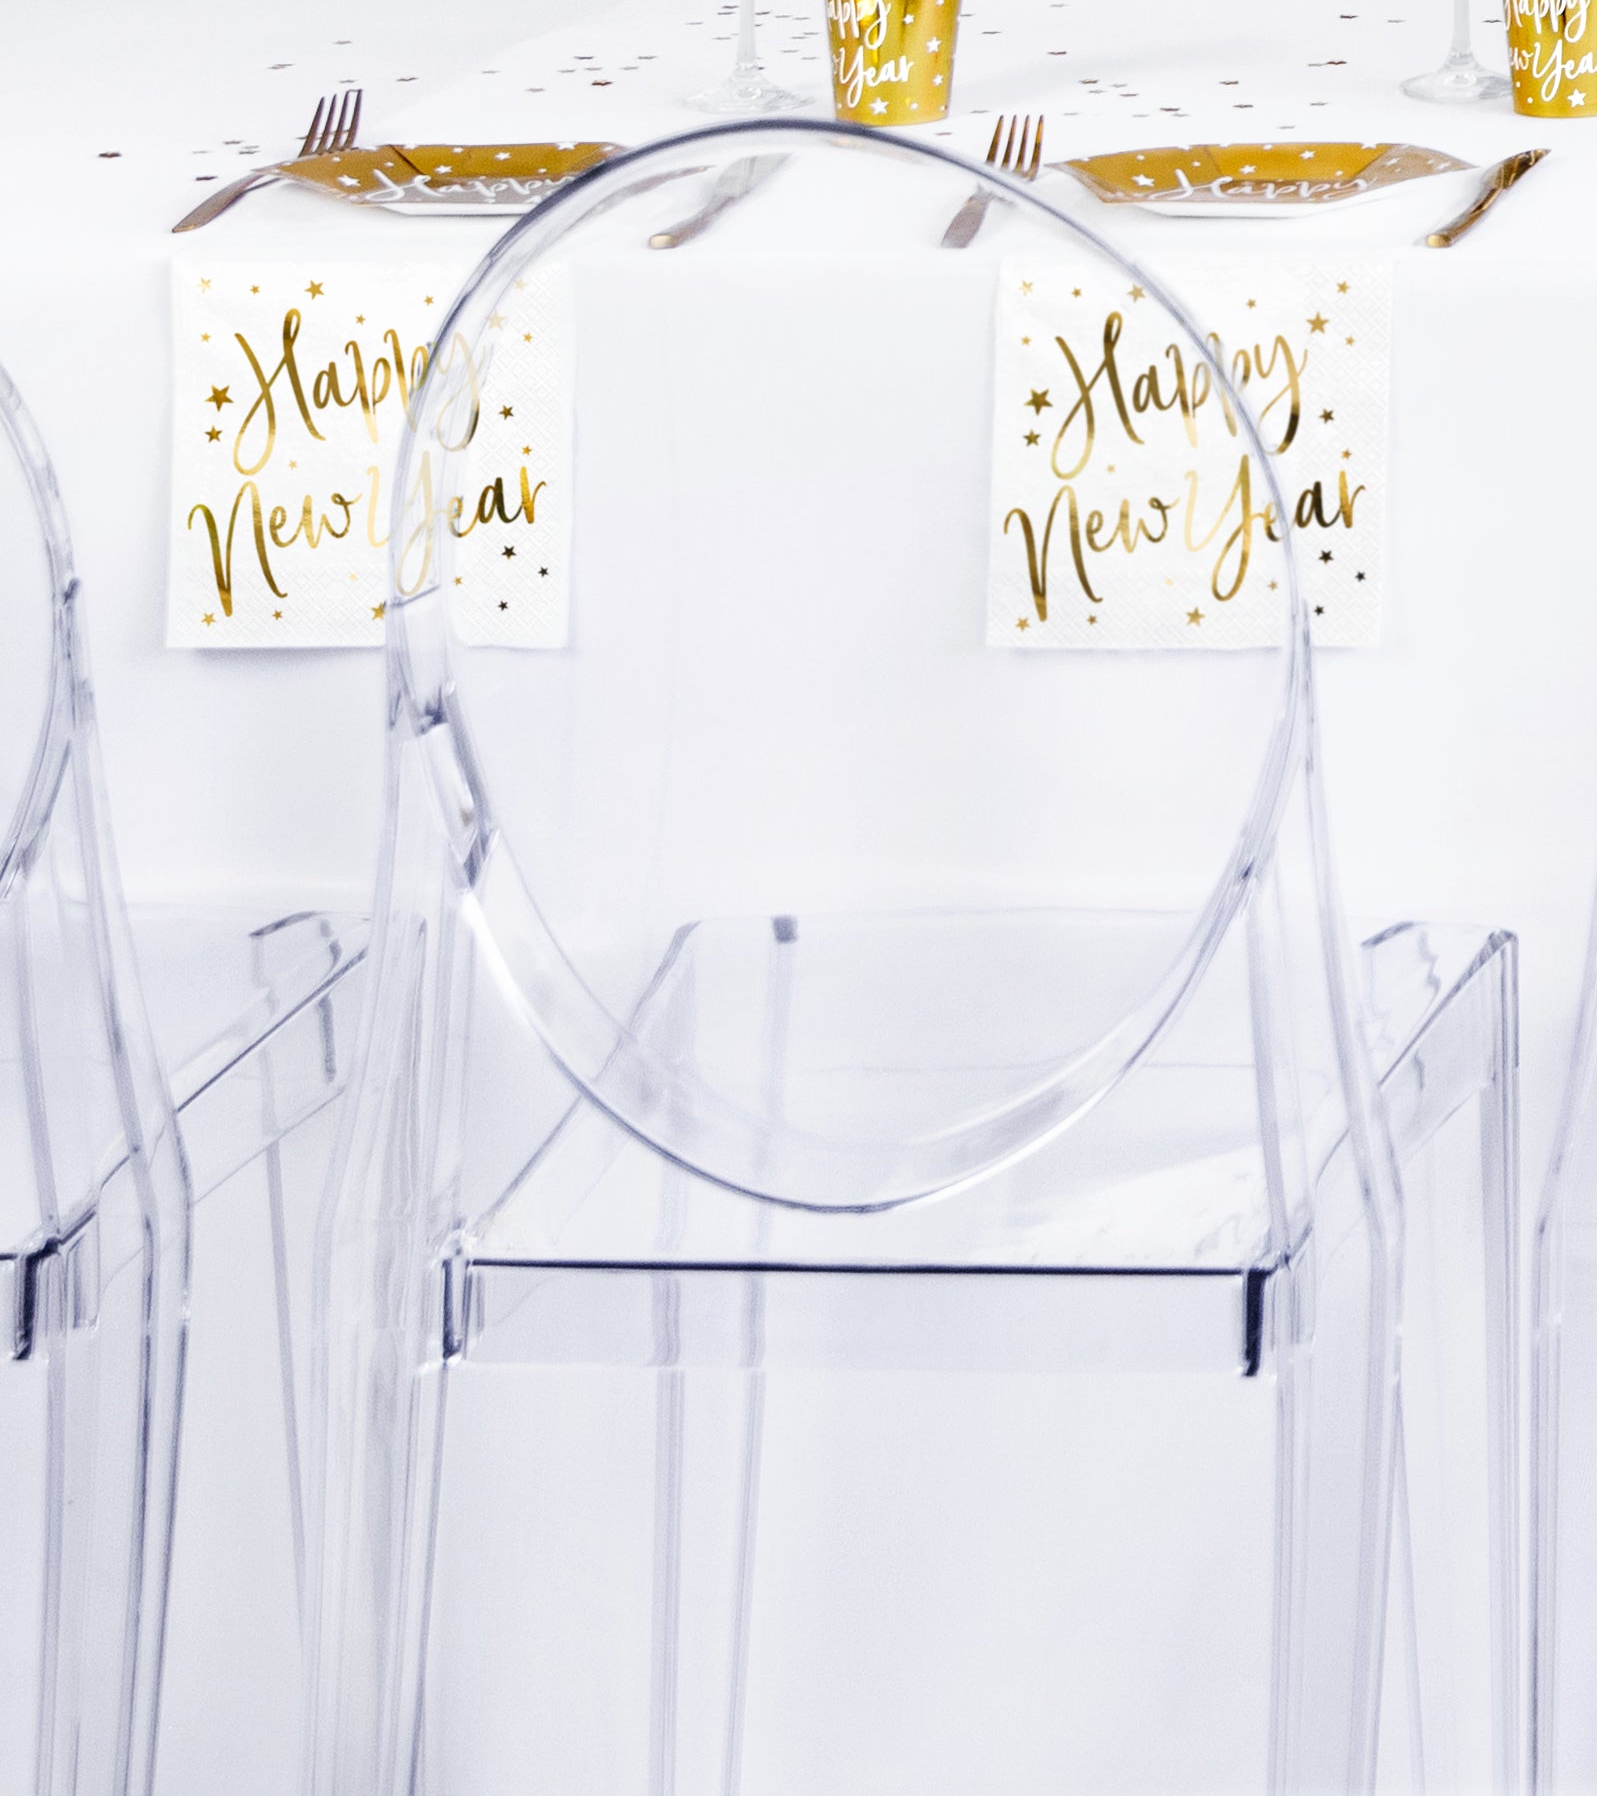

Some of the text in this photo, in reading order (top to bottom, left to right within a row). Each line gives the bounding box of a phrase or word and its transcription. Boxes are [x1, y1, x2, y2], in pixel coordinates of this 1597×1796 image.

[839, 45, 914, 108] Year
[1149, 168, 1379, 200] Happy
[233, 308, 492, 476] Happy
[1050, 311, 1308, 480] Happy
[188, 451, 547, 617] New Year
[1003, 454, 1366, 622] New Year
